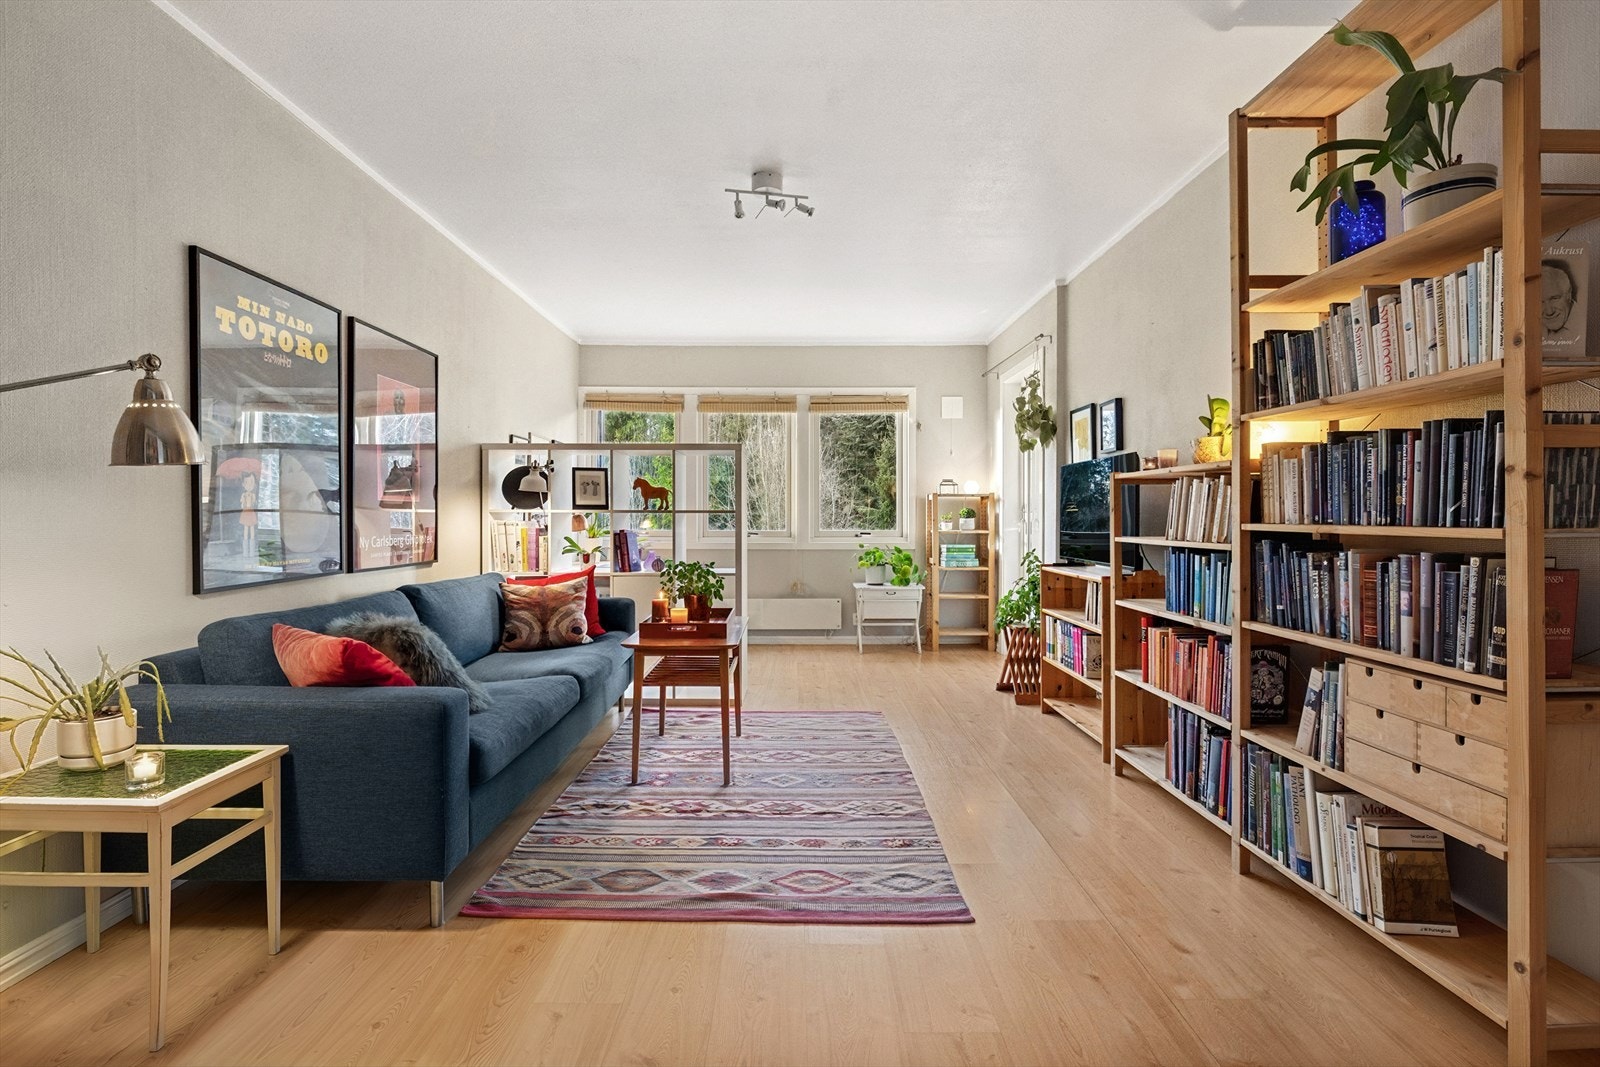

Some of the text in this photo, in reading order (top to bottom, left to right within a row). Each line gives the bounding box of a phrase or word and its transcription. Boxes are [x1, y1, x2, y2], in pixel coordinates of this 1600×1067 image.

[1545, 246, 1584, 255] Aukrust
[215, 305, 329, 364] TOTORO
[237, 295, 271, 319] MIN
[275, 310, 314, 335] NABO
[1354, 326, 1364, 366] Sapiens
[359, 536, 370, 551] Ny
[371, 534, 404, 549] Carlsberg
[1545, 575, 1564, 583] ENSEN
[1249, 762, 1257, 809] Limnology
[1290, 775, 1300, 825] PATHOLOGY
[1298, 770, 1306, 799] PLANT
